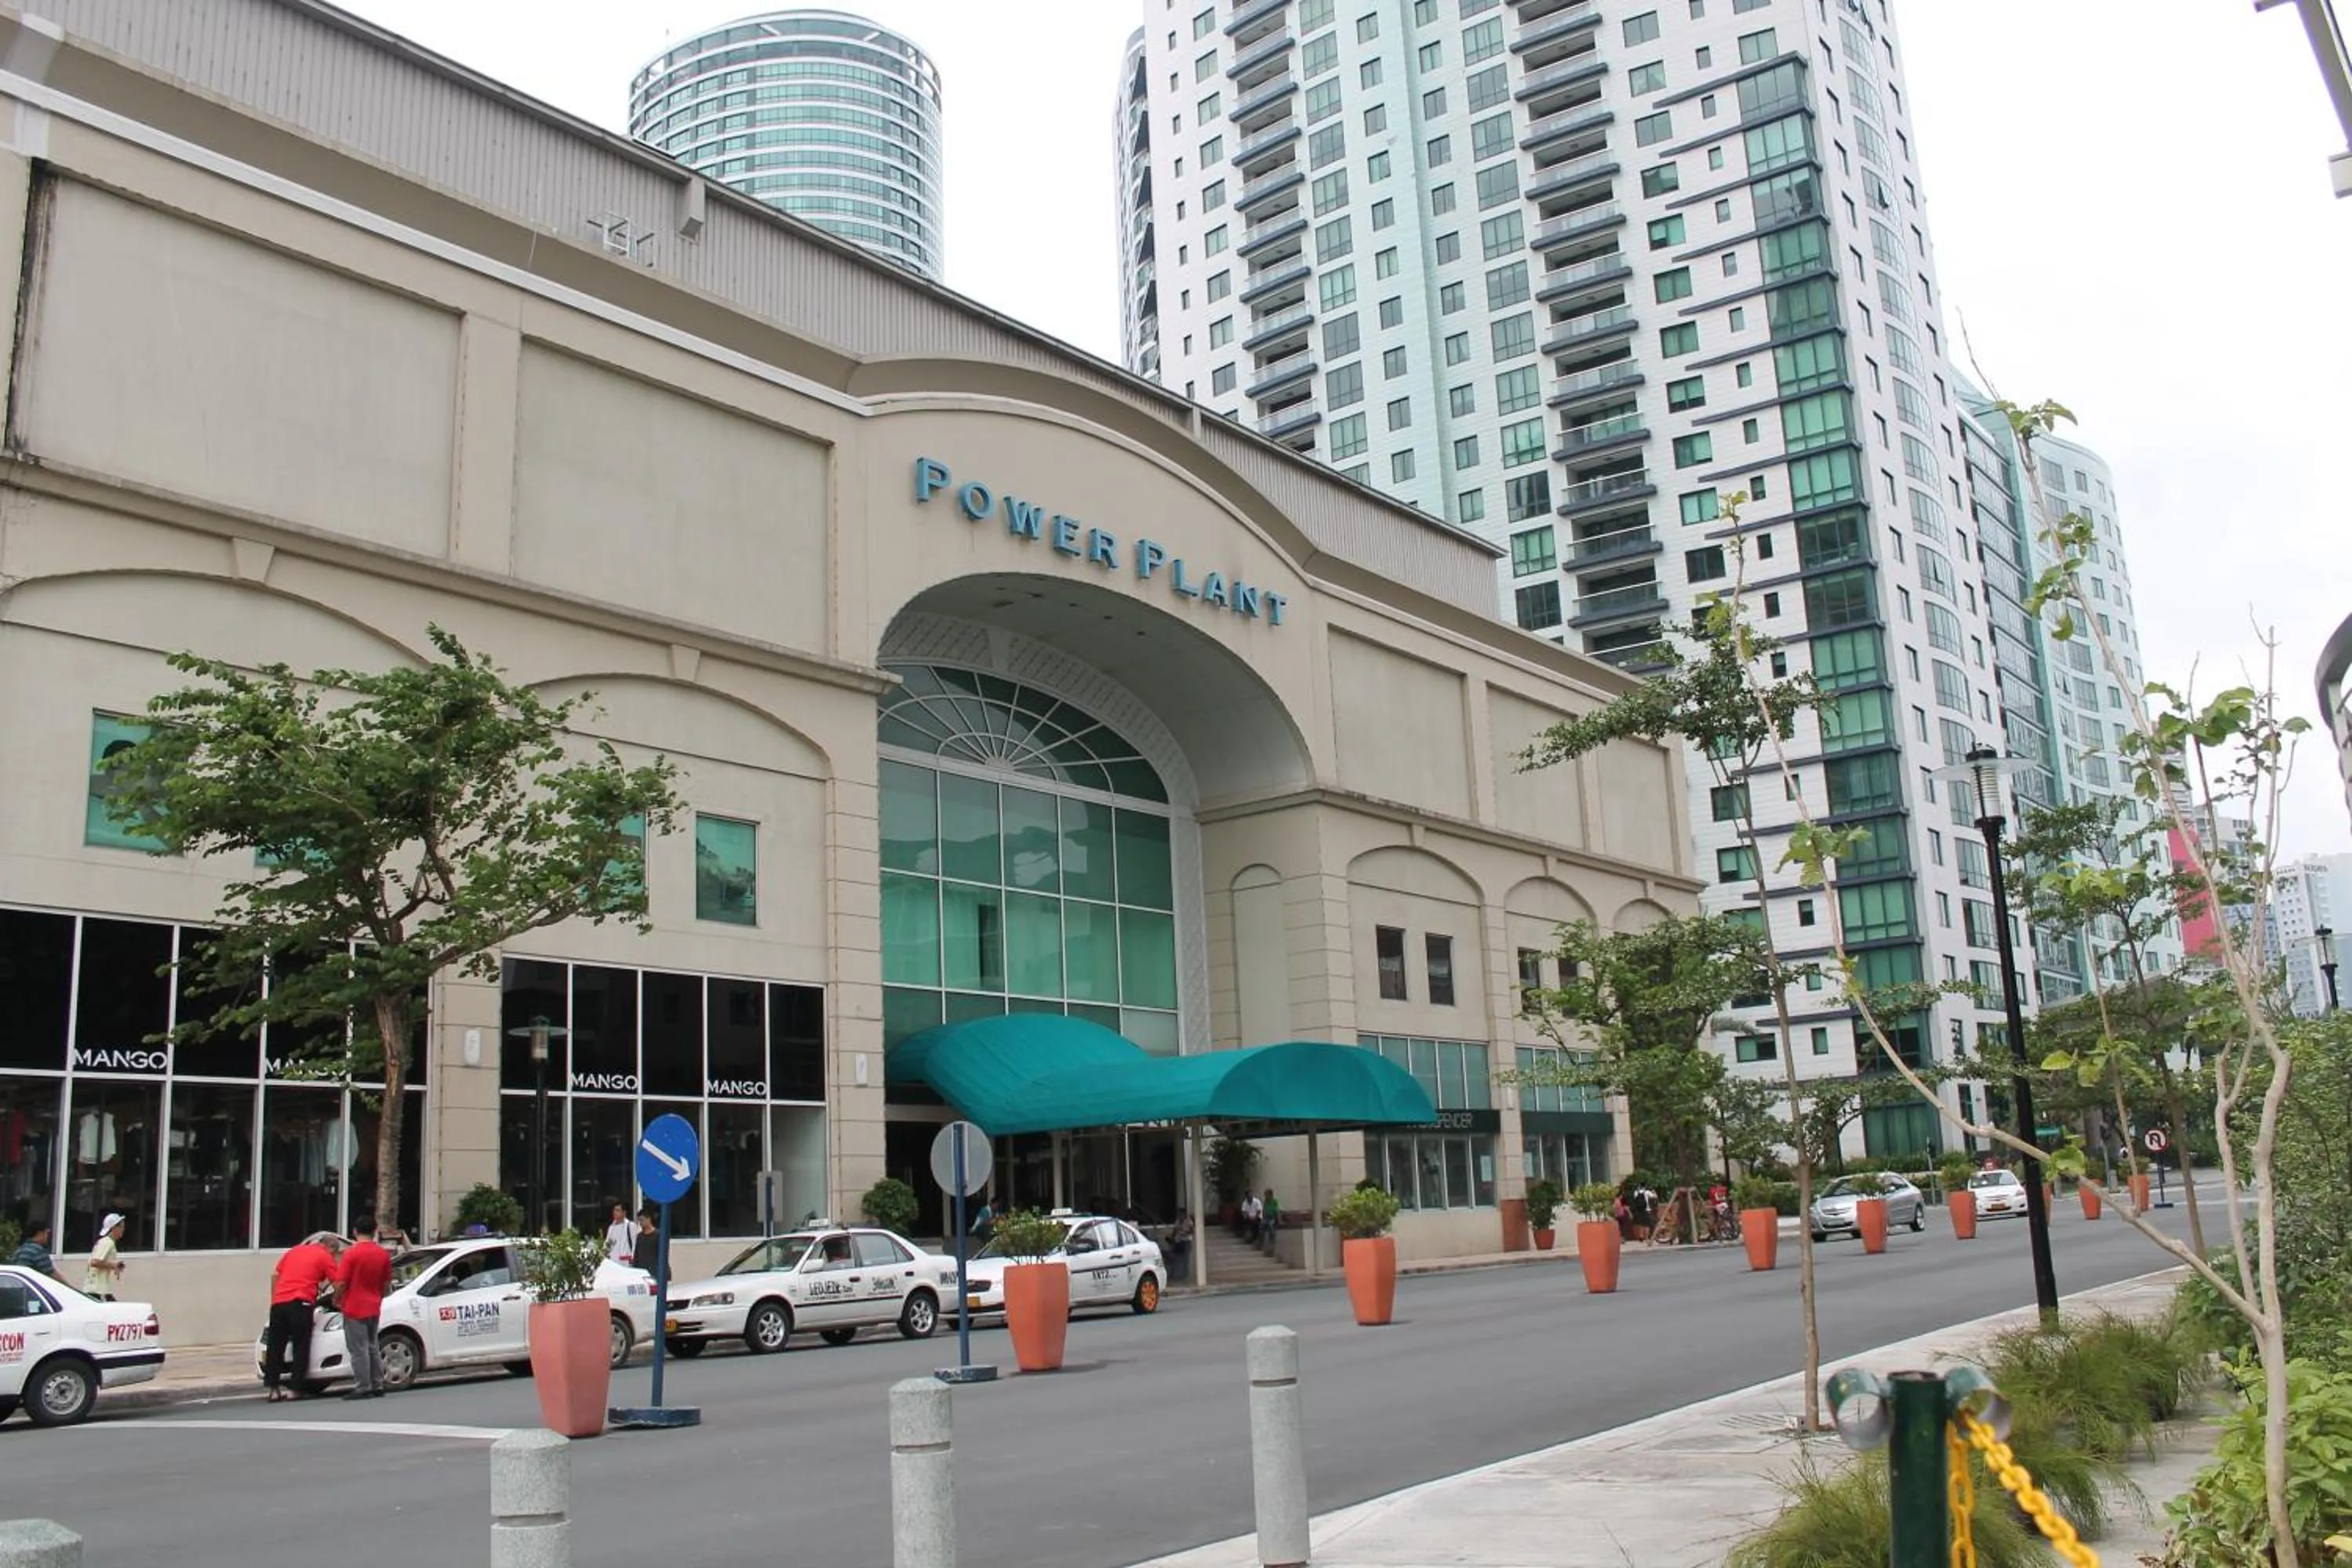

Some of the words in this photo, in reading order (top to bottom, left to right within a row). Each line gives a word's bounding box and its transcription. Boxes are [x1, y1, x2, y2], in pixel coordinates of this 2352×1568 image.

[916, 456, 1120, 570] POWER
[1136, 538, 1287, 626] PLANT
[72, 1048, 167, 1069] MANGO
[570, 1072, 638, 1091] MANGO
[706, 1079, 768, 1096] MANGO
[457, 1302, 499, 1320] TAI-PAN
[0, 1332, 24, 1352] CON
